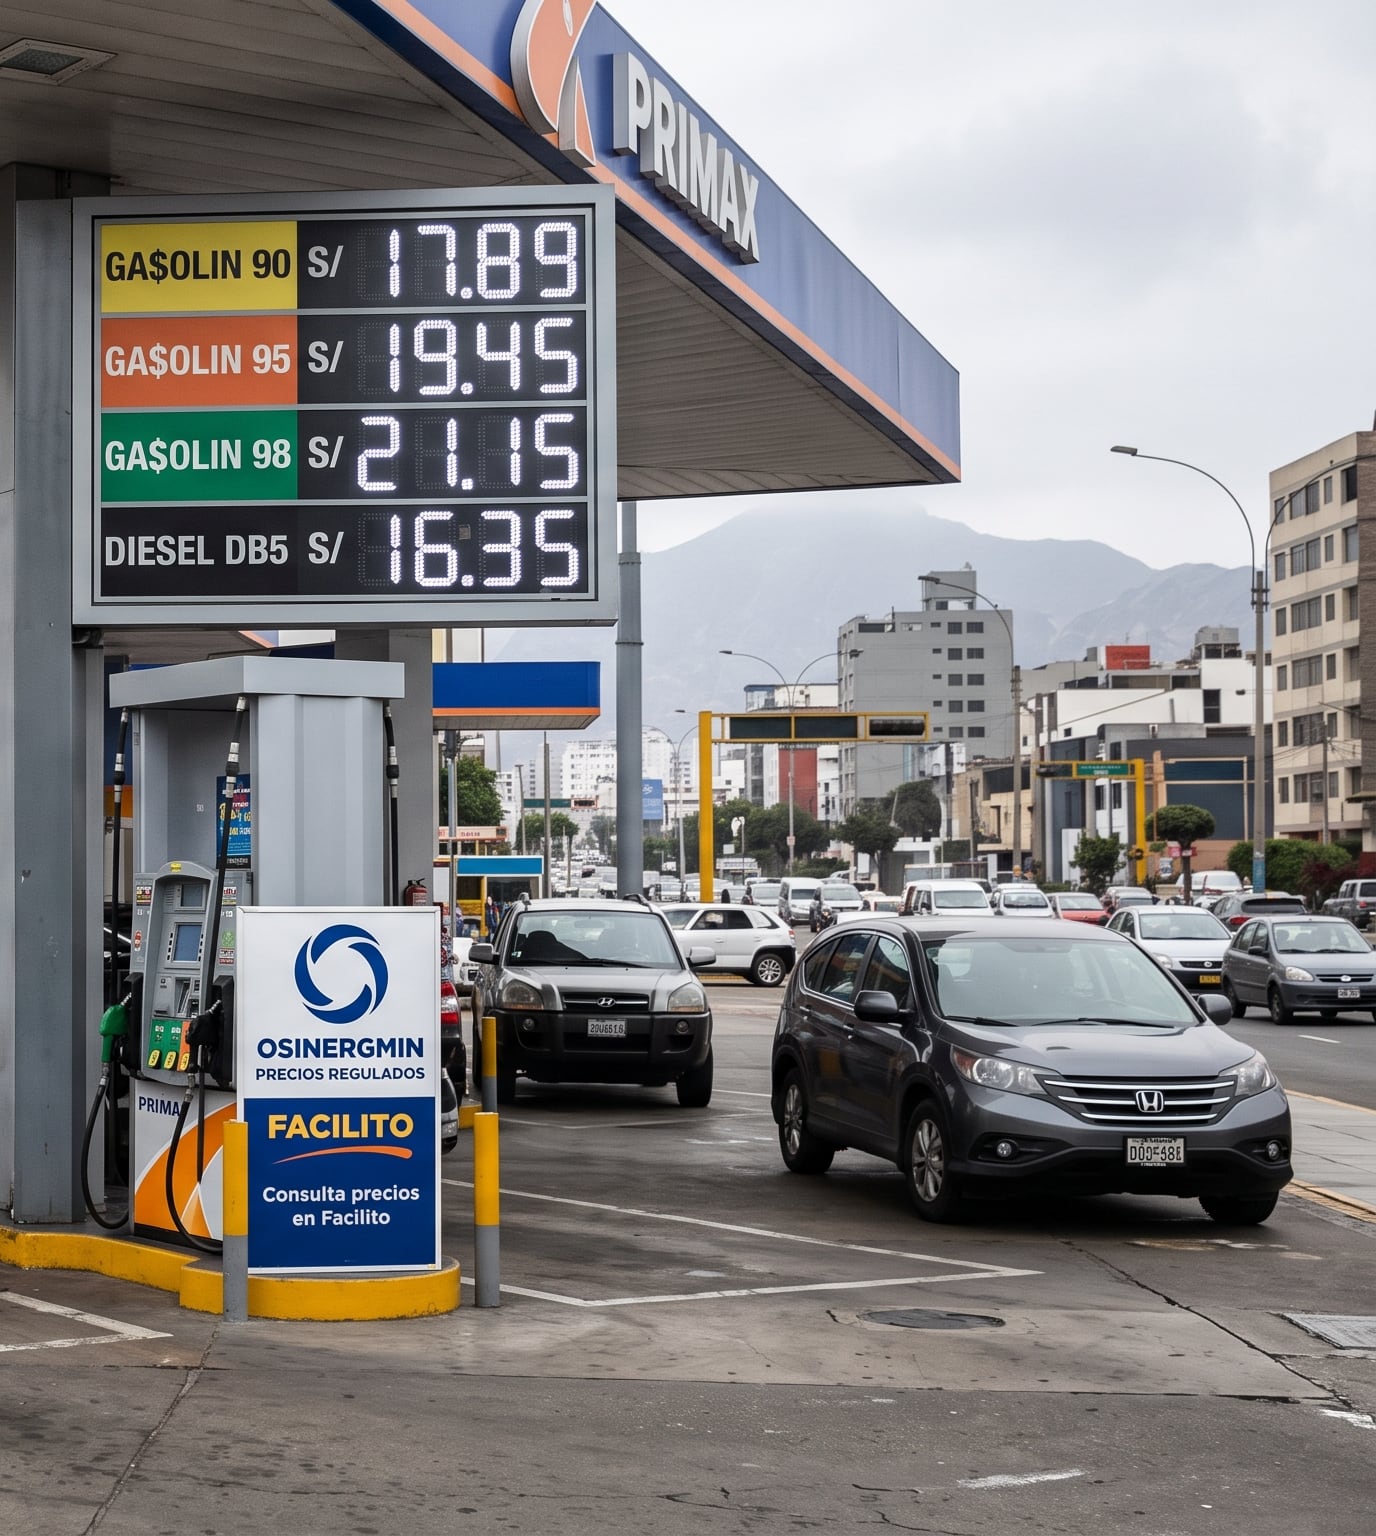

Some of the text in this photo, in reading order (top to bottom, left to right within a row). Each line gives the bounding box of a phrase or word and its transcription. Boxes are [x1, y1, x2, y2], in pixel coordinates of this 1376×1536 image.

[612, 52, 759, 264] PRIMAX
[252, 248, 291, 279] 90
[307, 245, 343, 277] S/
[389, 222, 579, 299] 17.89
[252, 343, 291, 374] 95
[307, 340, 343, 373] S/
[389, 318, 579, 396] 19.45
[252, 438, 291, 470] 98
[307, 436, 343, 468] S/
[357, 413, 579, 491] 21.15
[105, 510, 579, 586] DIESEL DB5 S/ 16.35
[257, 1037, 424, 1059] OSINERGMIN
[256, 1067, 425, 1081] PRECIOS REGULADOS
[139, 1095, 181, 1117] PRIMA
[267, 1113, 414, 1139] FACILITO
[262, 1184, 420, 1203] Consulta precios
[292, 1210, 391, 1226] en Facilito
